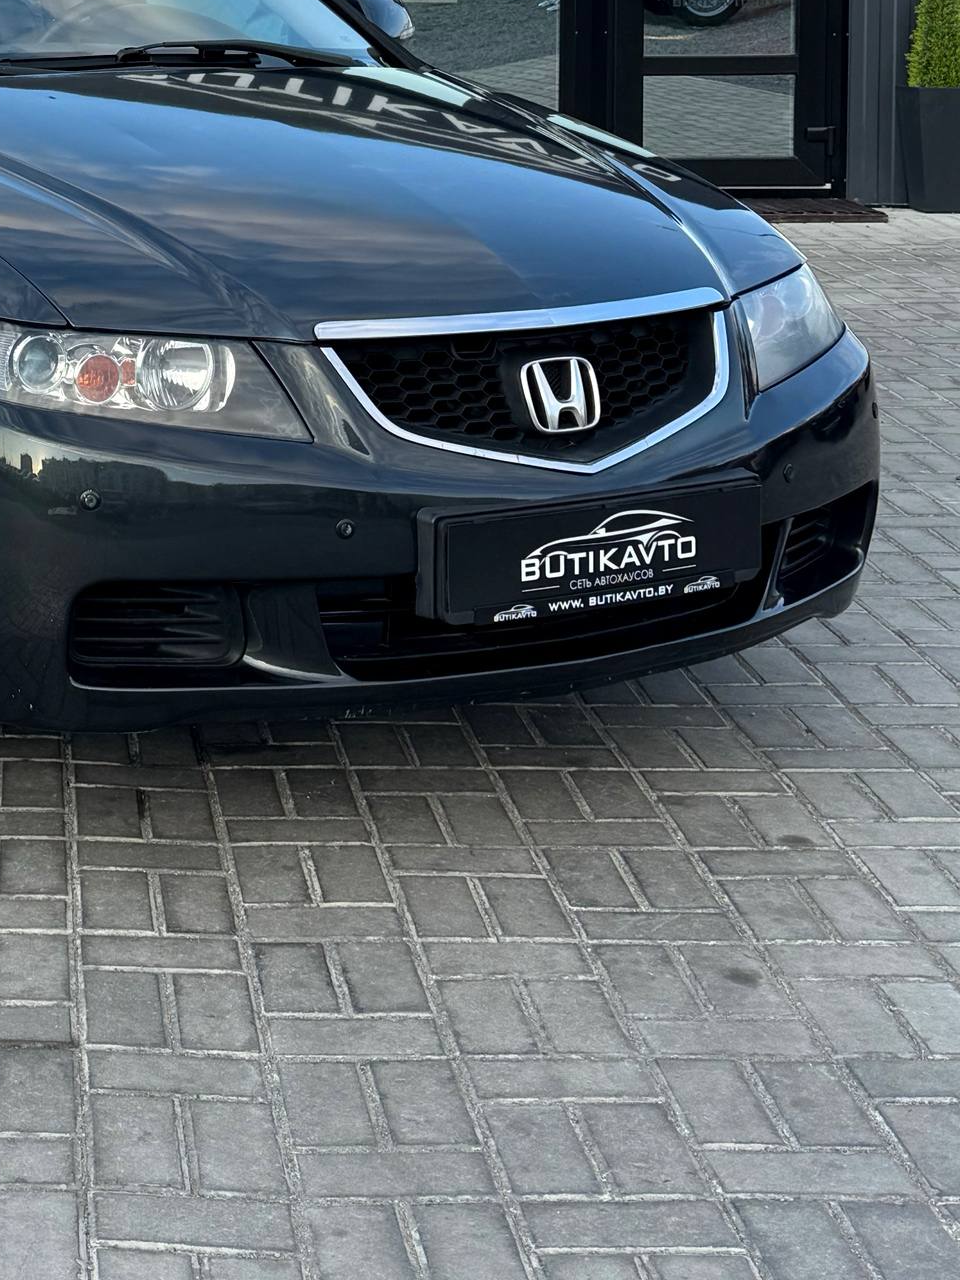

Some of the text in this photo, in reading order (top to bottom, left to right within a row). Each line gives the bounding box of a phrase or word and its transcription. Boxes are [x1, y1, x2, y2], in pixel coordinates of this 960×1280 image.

[521, 536, 697, 582] BUTIKAVTO
[569, 568, 654, 590] СЕТЬ АВТОХАУСОВ
[683, 581, 721, 594] BUTIKAVTO
[548, 583, 674, 612] WWW. BUTIKAVTO.BY
[493, 609, 538, 622] BUTIKAVTO
